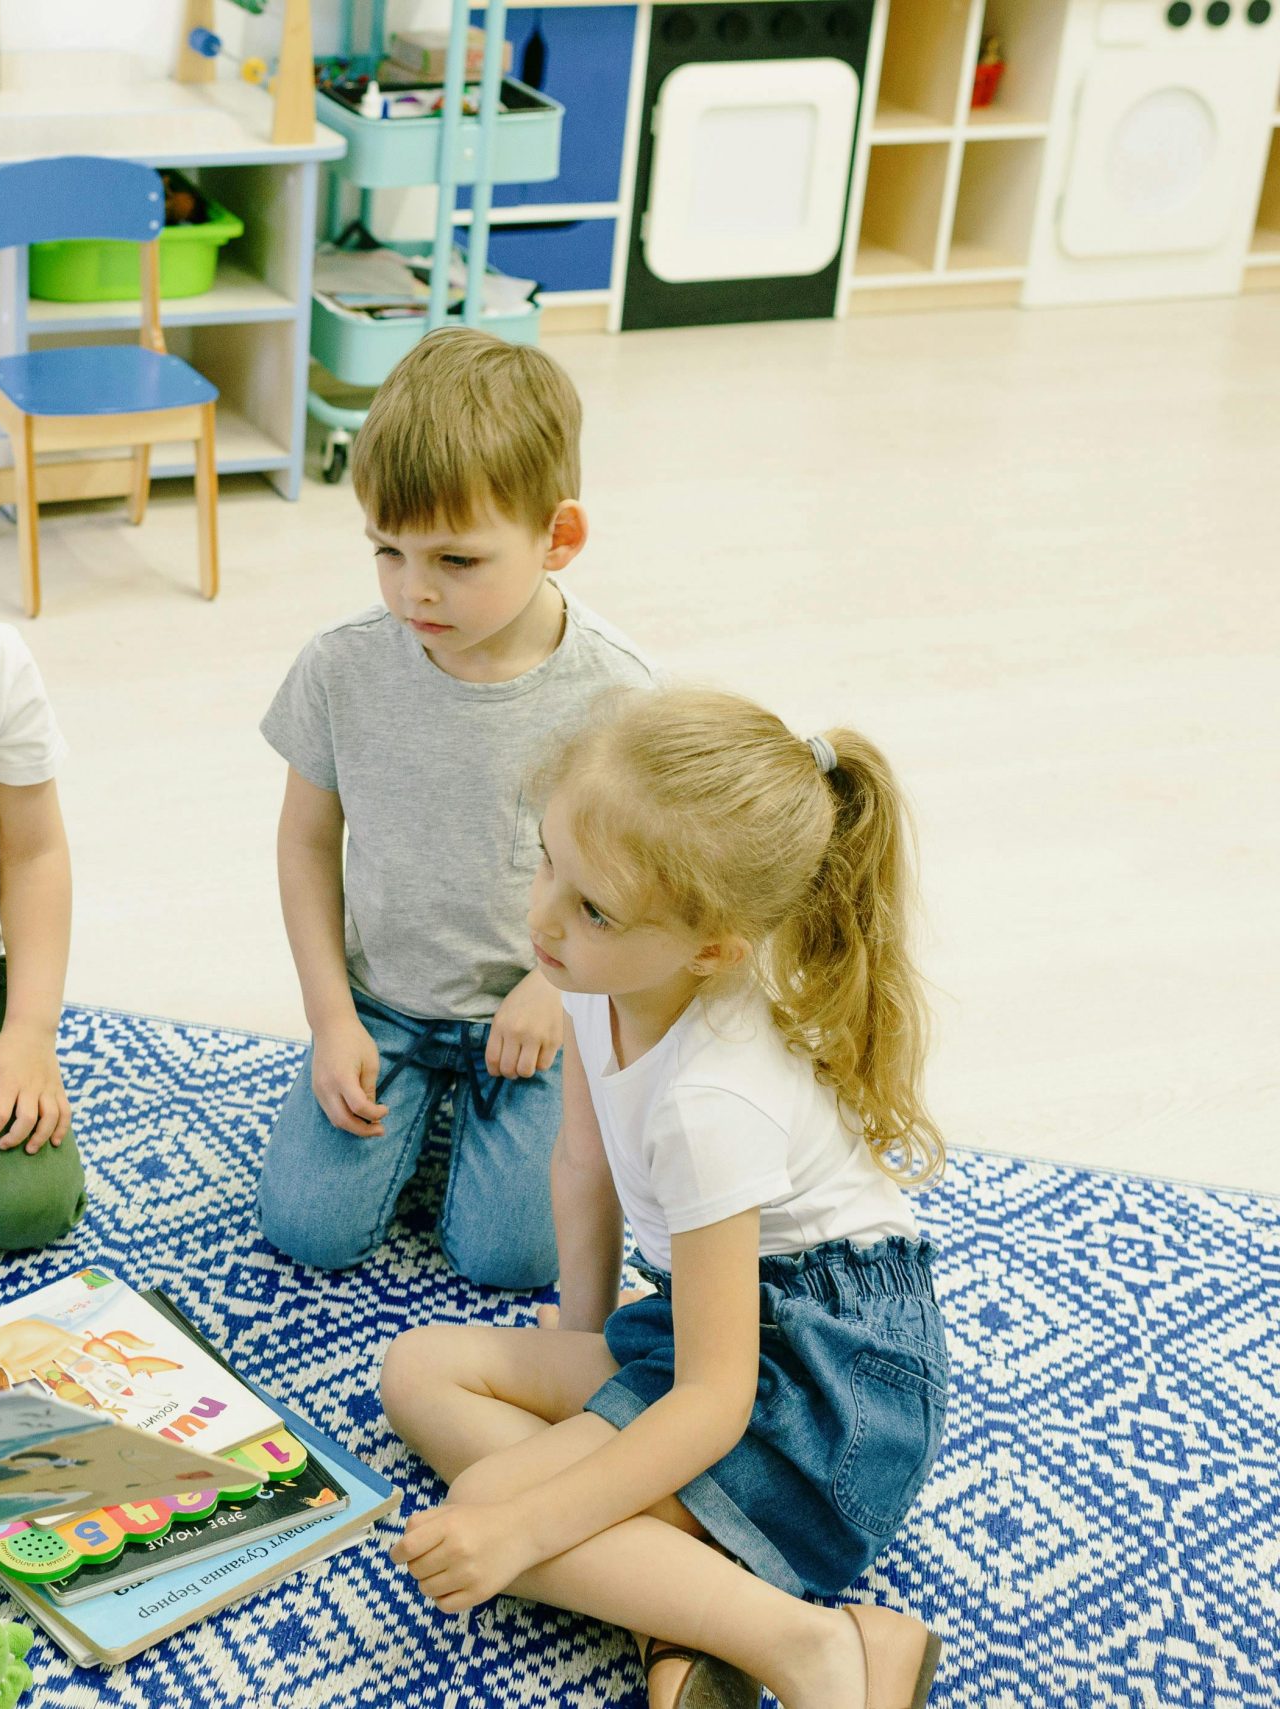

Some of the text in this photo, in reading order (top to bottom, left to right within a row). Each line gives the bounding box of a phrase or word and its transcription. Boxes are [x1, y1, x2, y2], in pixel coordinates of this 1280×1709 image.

[261, 1441, 290, 1464] 1
[120, 1502, 160, 1526] 4
[74, 1520, 109, 1547] 5
[145, 1510, 247, 1551] ЭРВЕ ТЮЛЛЕ
[200, 1546, 269, 1585] Сузанна
[137, 1584, 204, 1620] Бернер
